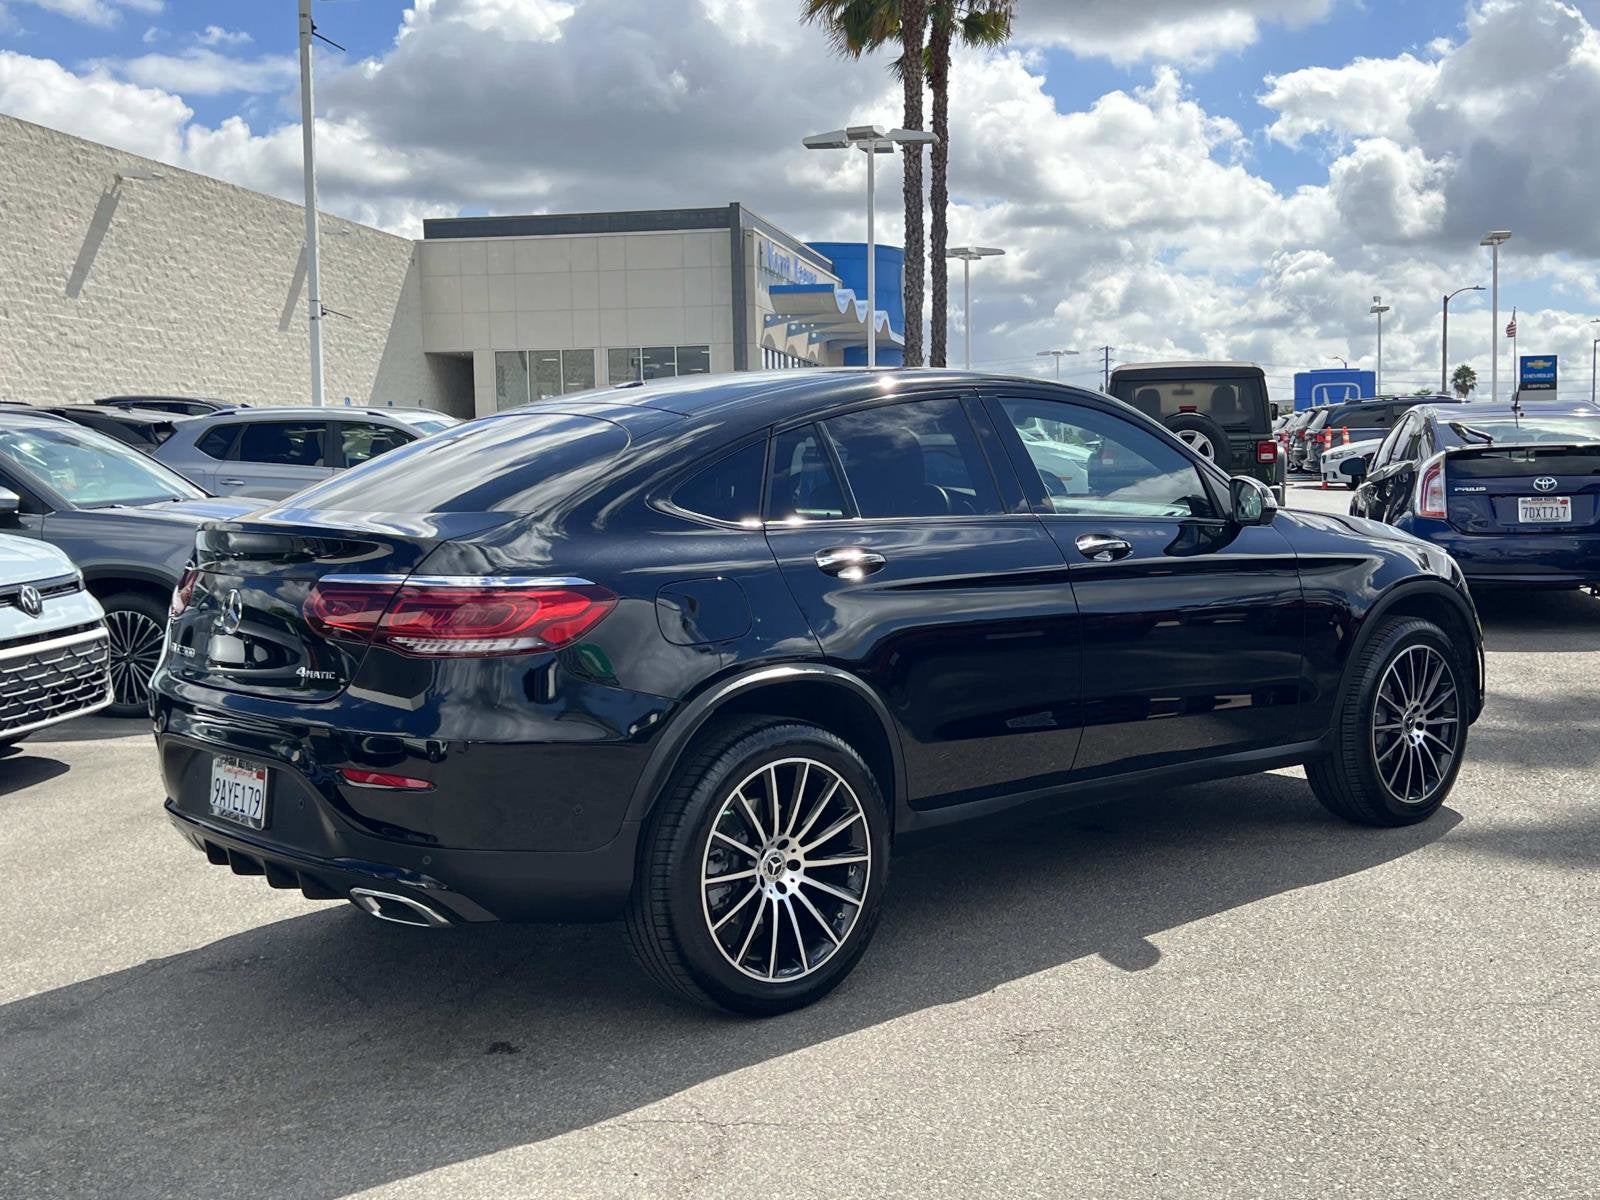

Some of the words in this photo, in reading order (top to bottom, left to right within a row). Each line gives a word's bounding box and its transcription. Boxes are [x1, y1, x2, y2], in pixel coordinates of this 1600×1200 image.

[1522, 506, 1567, 519] 7DXT717
[295, 666, 336, 680] 4MATIC
[212, 777, 262, 816] 9AYE179
